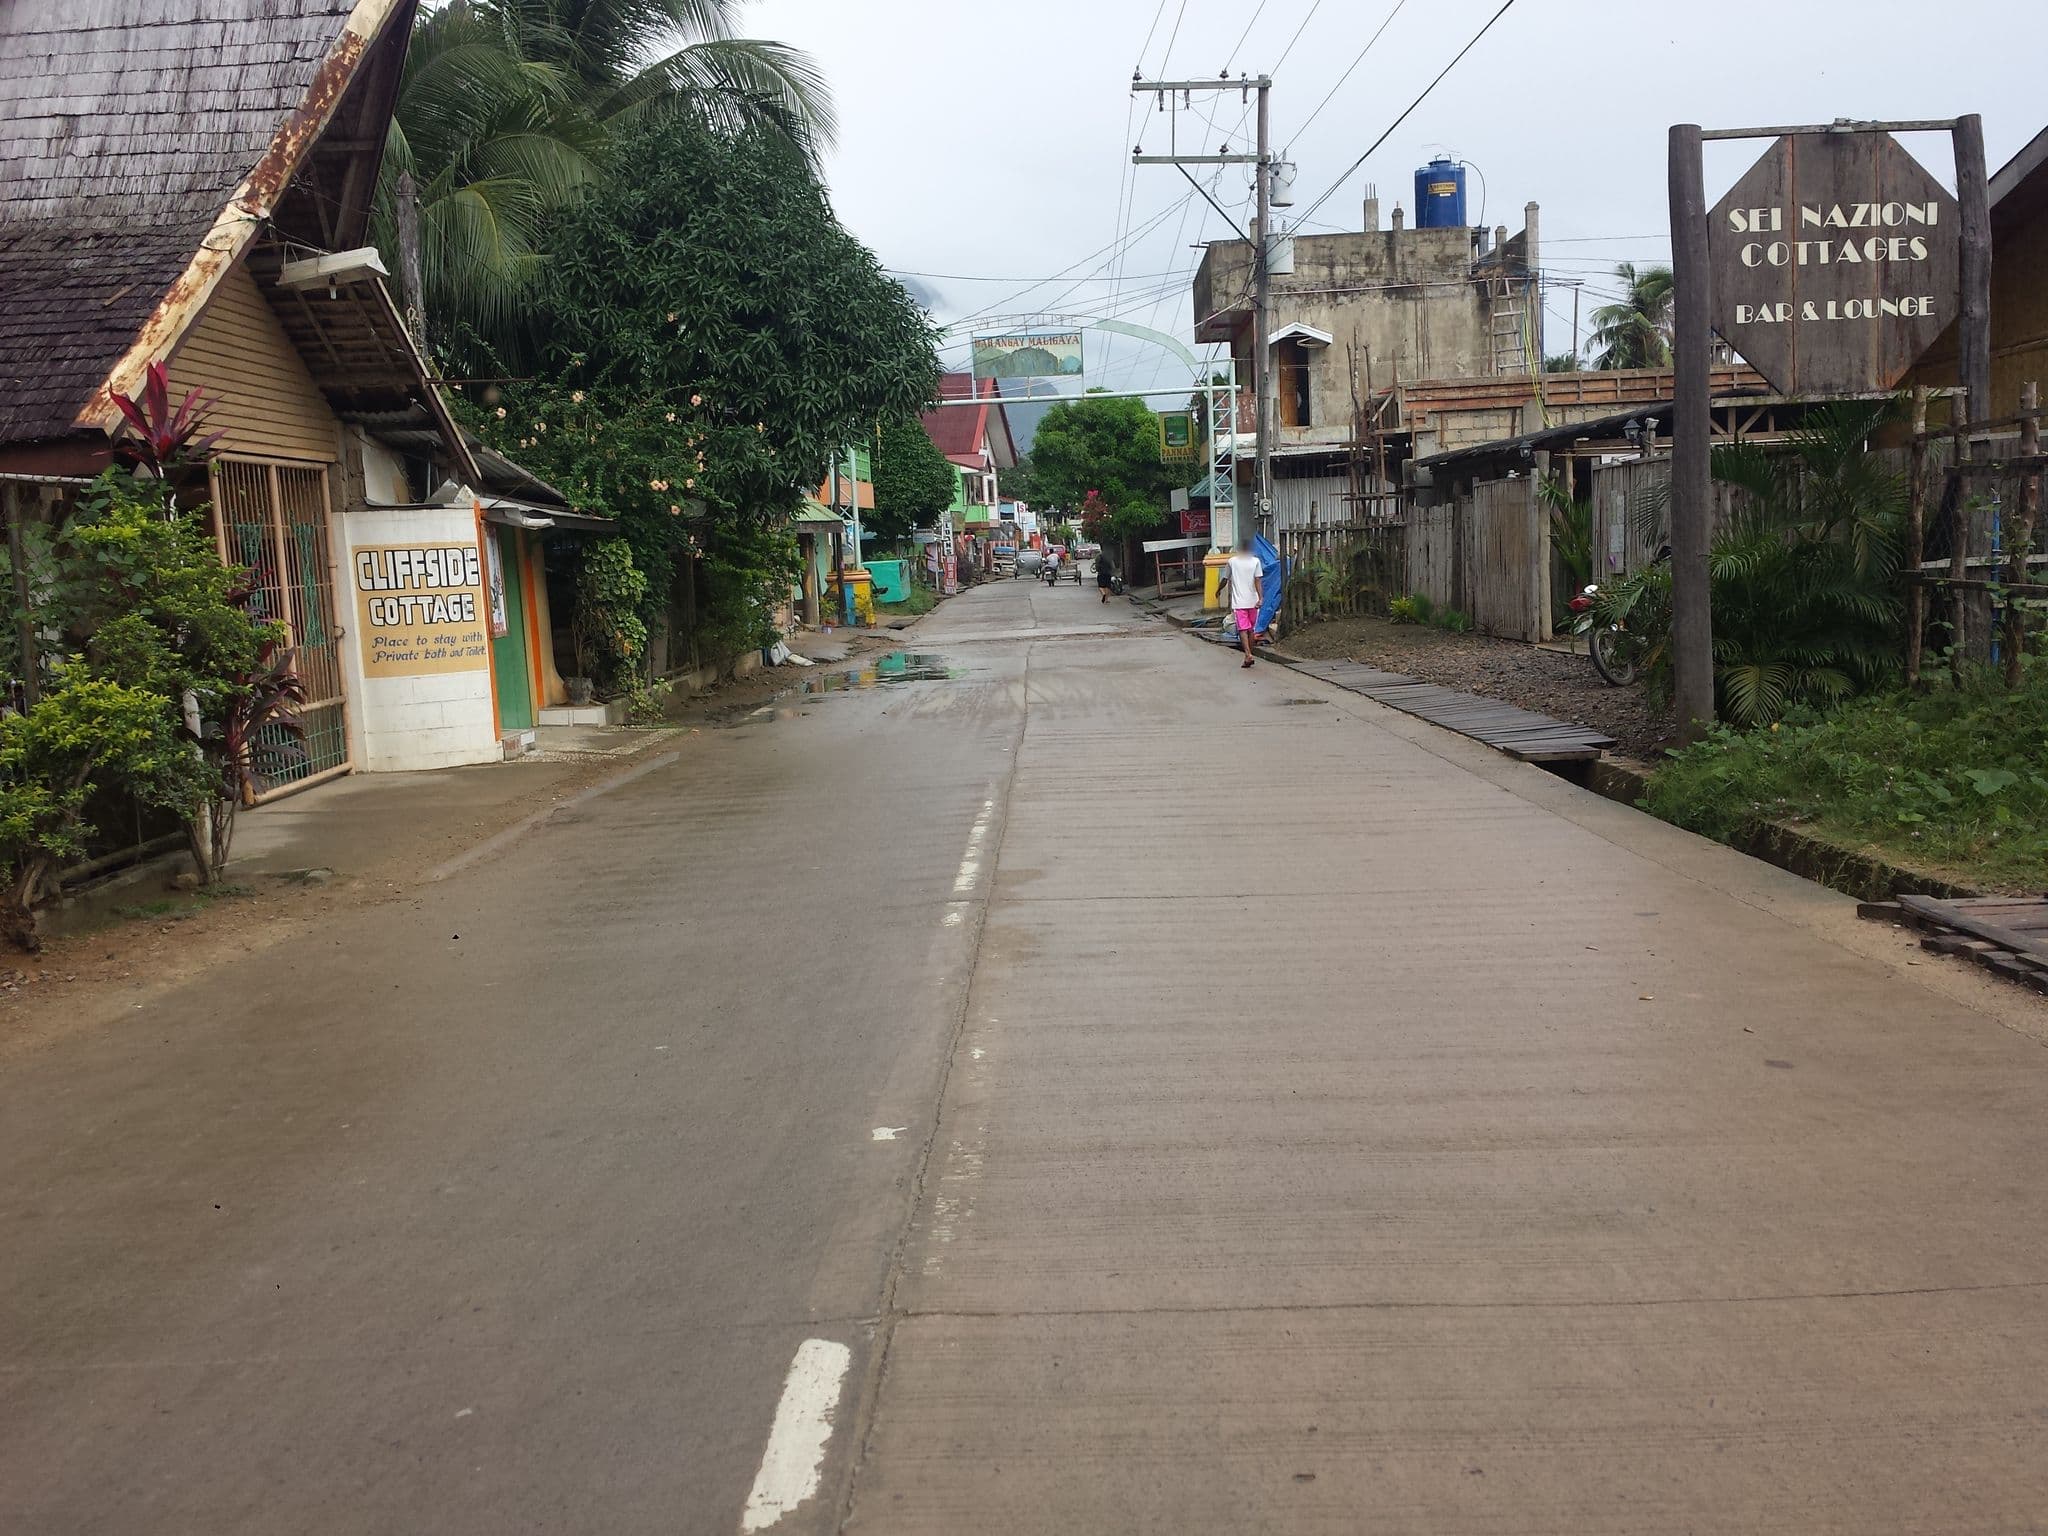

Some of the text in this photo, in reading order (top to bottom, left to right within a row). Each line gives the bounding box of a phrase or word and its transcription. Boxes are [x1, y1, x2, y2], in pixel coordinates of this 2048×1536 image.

[1728, 202, 1938, 233] SEI NAZIONI
[1740, 236, 1929, 268] COTTAGES
[1735, 296, 1935, 324] BAR & LOUNGE
[974, 335, 1080, 349] BARANGAY MALIGAYA
[356, 547, 480, 591] CLIFFSIDE
[368, 593, 475, 626] COTTAGE
[372, 632, 483, 648] Place to stay with
[373, 650, 419, 663] Private
[424, 648, 447, 660] bath
